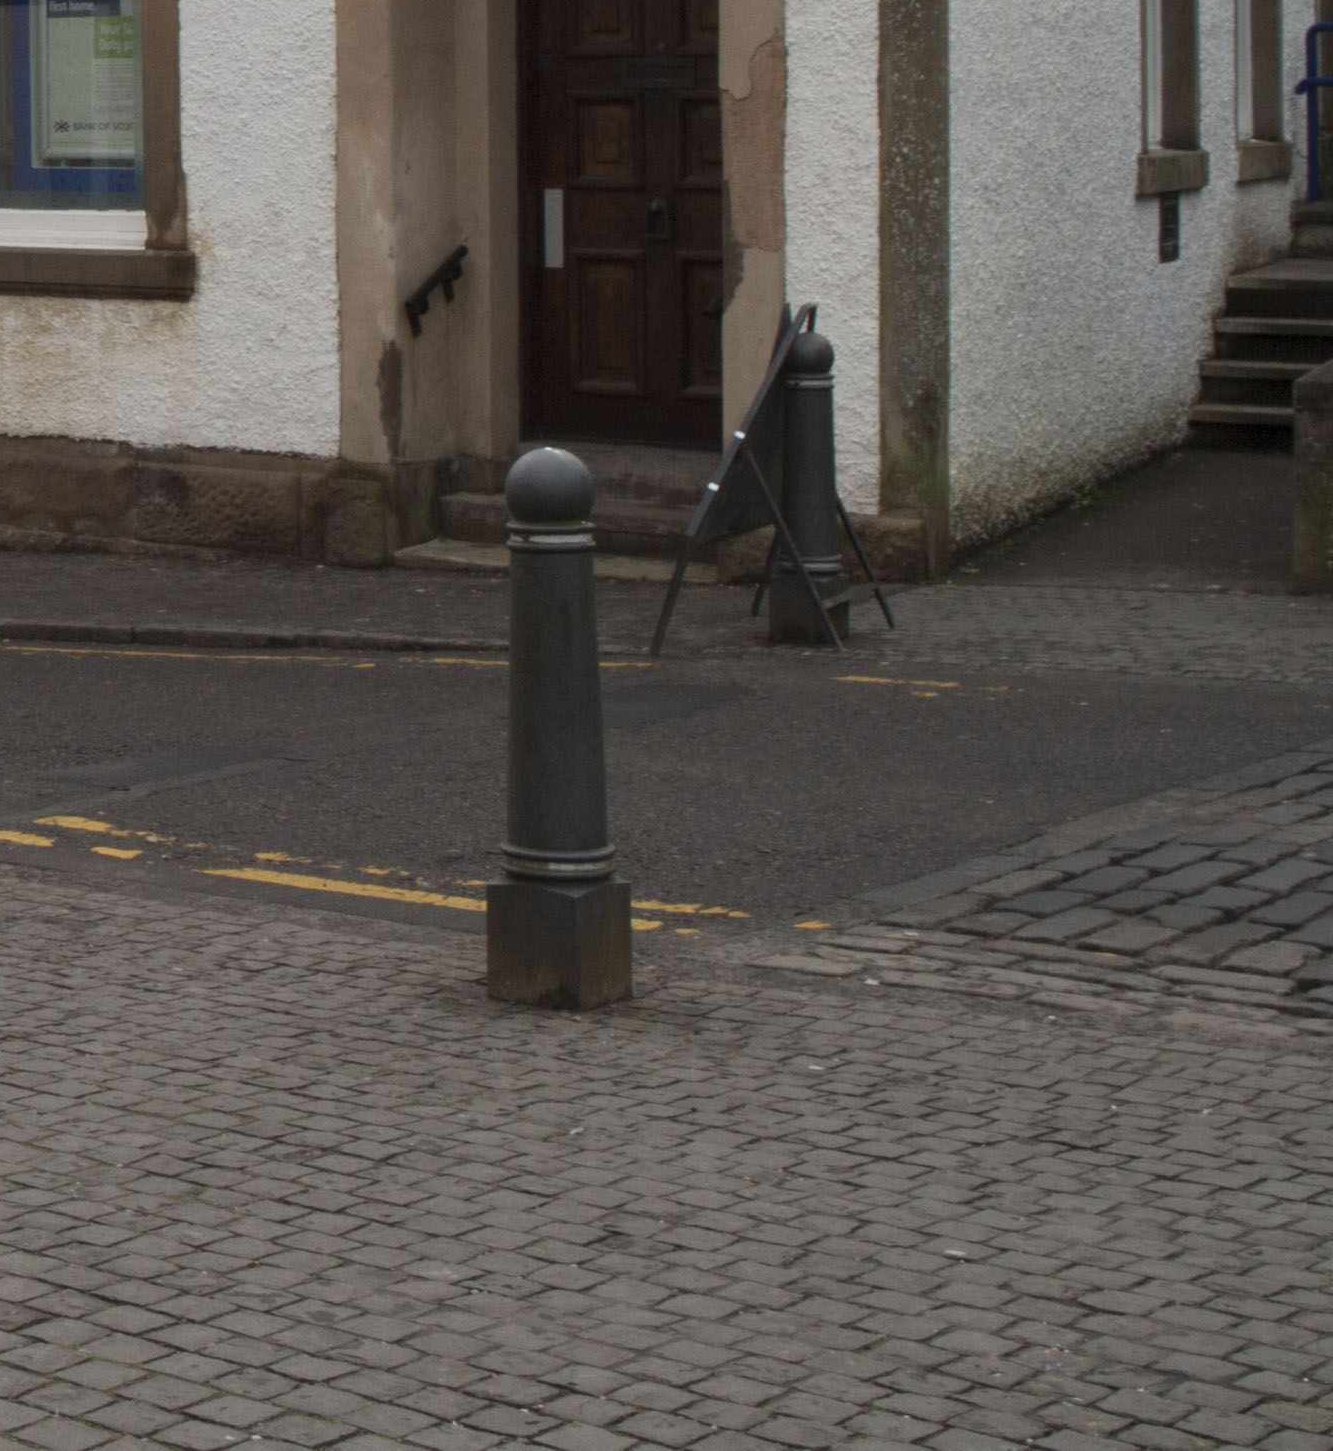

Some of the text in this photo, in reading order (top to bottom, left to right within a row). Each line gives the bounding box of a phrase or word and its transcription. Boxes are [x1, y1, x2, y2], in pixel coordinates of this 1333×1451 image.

[49, 1, 67, 12] first
[73, 122, 134, 132] BANK OF SCOT
